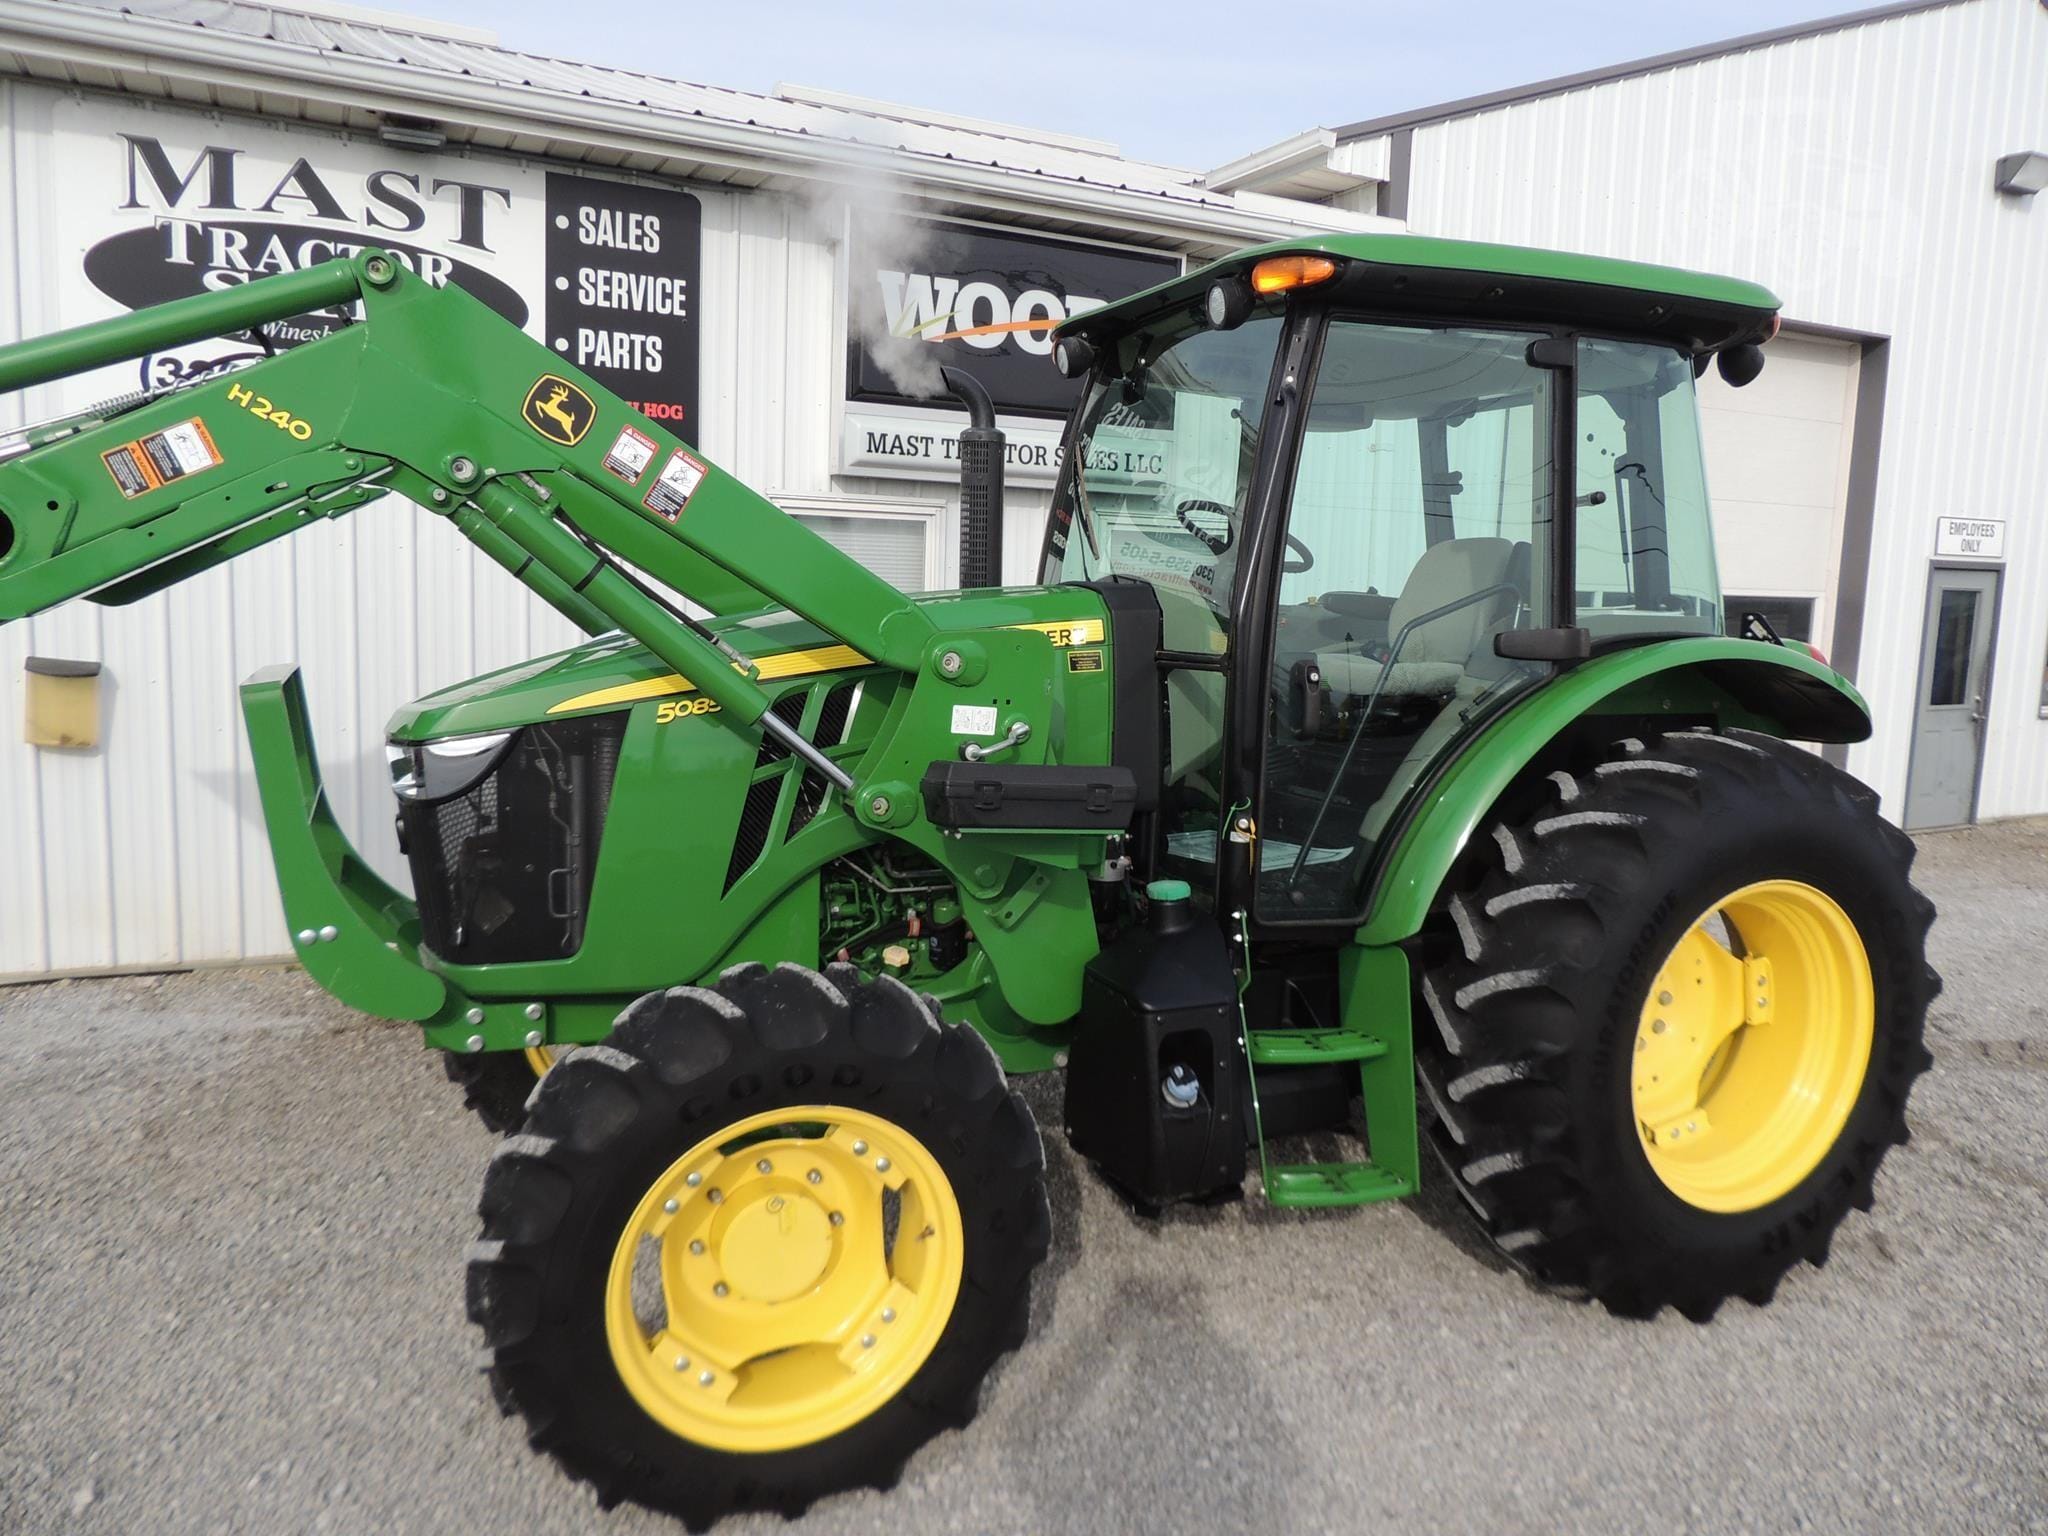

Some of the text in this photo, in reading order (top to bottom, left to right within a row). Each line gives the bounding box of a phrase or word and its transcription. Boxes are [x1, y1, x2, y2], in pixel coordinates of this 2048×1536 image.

[116, 132, 512, 254] MAST
[578, 206, 661, 254] SALES
[578, 267, 687, 317] SERVICE
[578, 328, 662, 373] PARTS
[227, 383, 312, 440] H240
[643, 402, 685, 420] HOG
[631, 431, 657, 450] DANGER
[866, 431, 935, 458] MAST
[941, 438, 1047, 466] TTOR
[1123, 452, 1162, 475] LLC
[681, 454, 706, 472] DANGER
[1948, 521, 1996, 538] EMPLOYEES
[1960, 538, 1982, 553] ONLY
[656, 697, 722, 724] 5085
